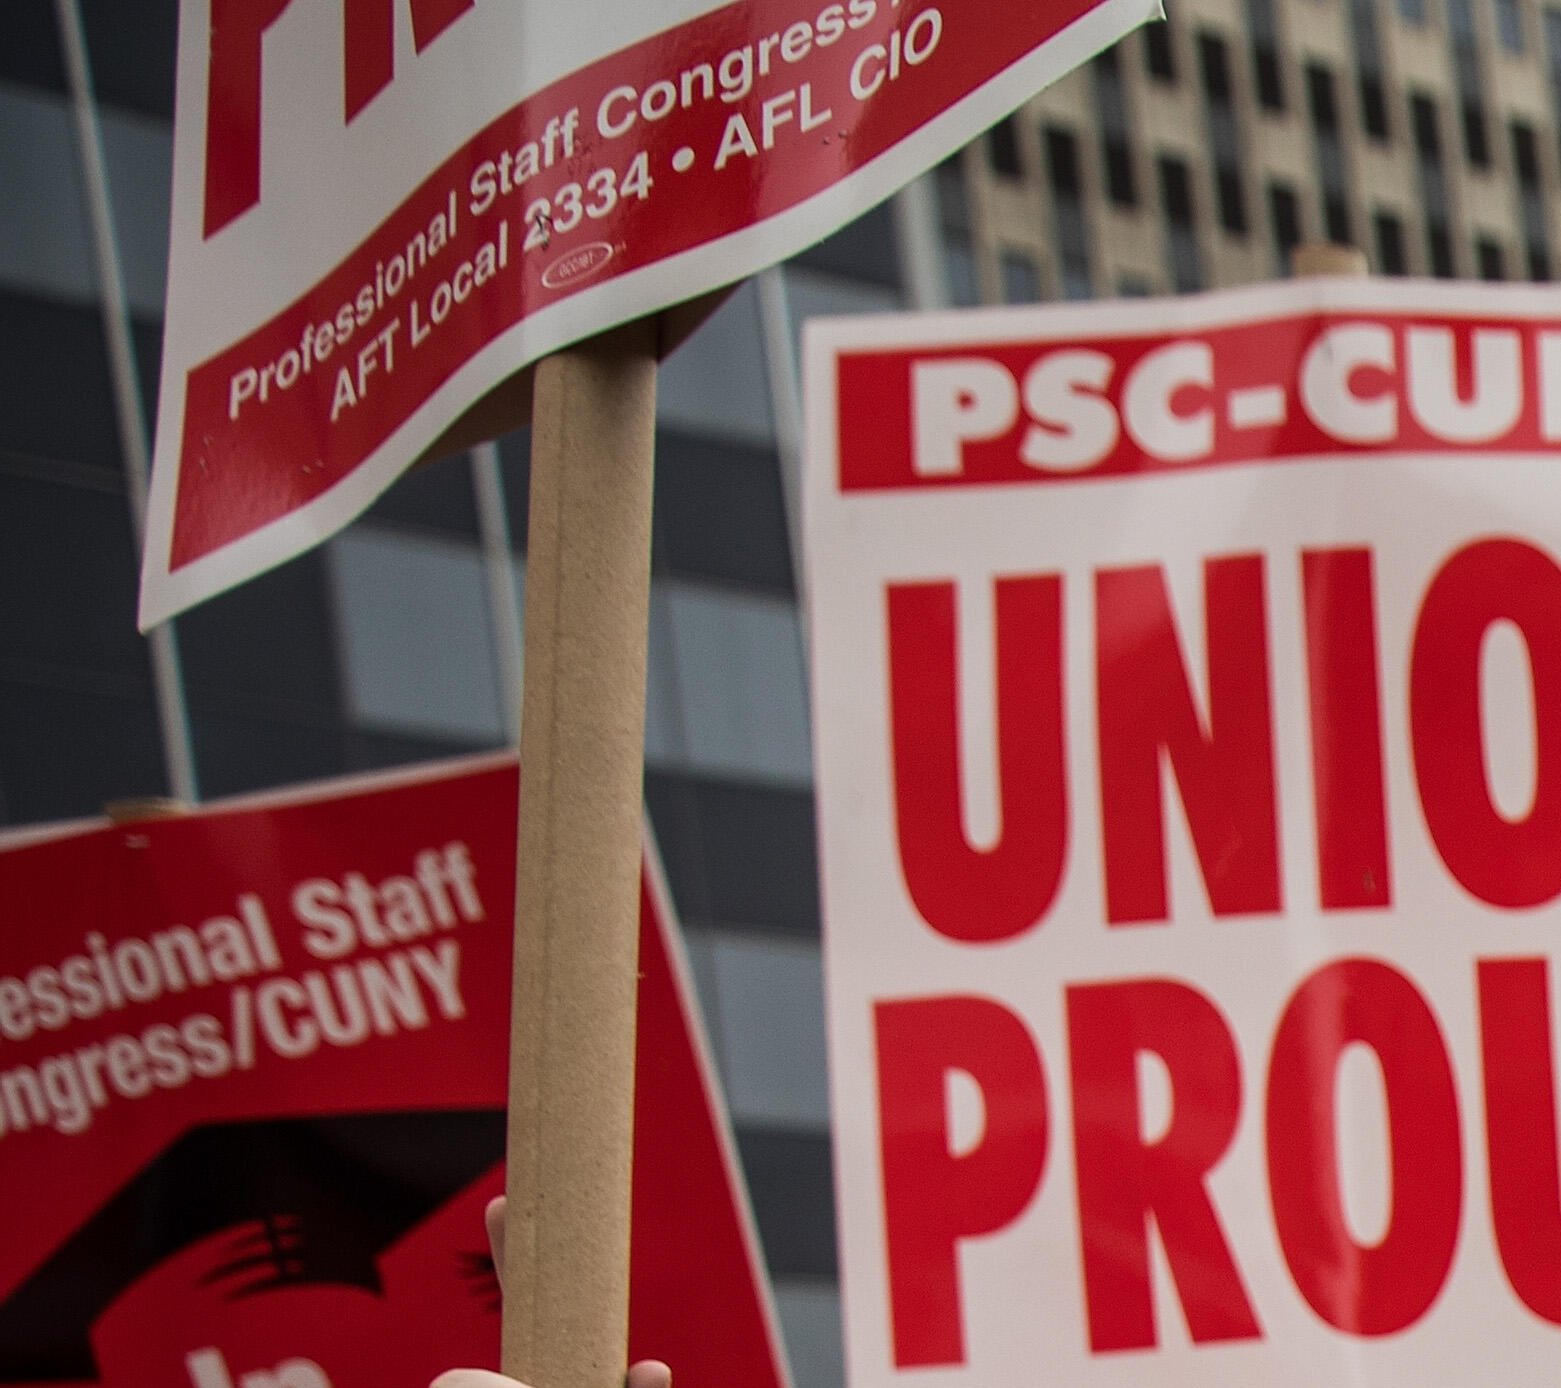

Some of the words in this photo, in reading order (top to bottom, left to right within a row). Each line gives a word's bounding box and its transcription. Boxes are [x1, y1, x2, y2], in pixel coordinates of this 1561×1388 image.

[229, 191, 457, 420] Professional
[470, 107, 579, 216] Staff
[597, 0, 876, 139] Congress
[331, 318, 400, 422] AFT
[410, 220, 508, 348] Local
[523, 151, 654, 253] 2334
[713, 83, 833, 170] AFL
[849, 8, 943, 100] CIO
[292, 841, 484, 958] Staff
